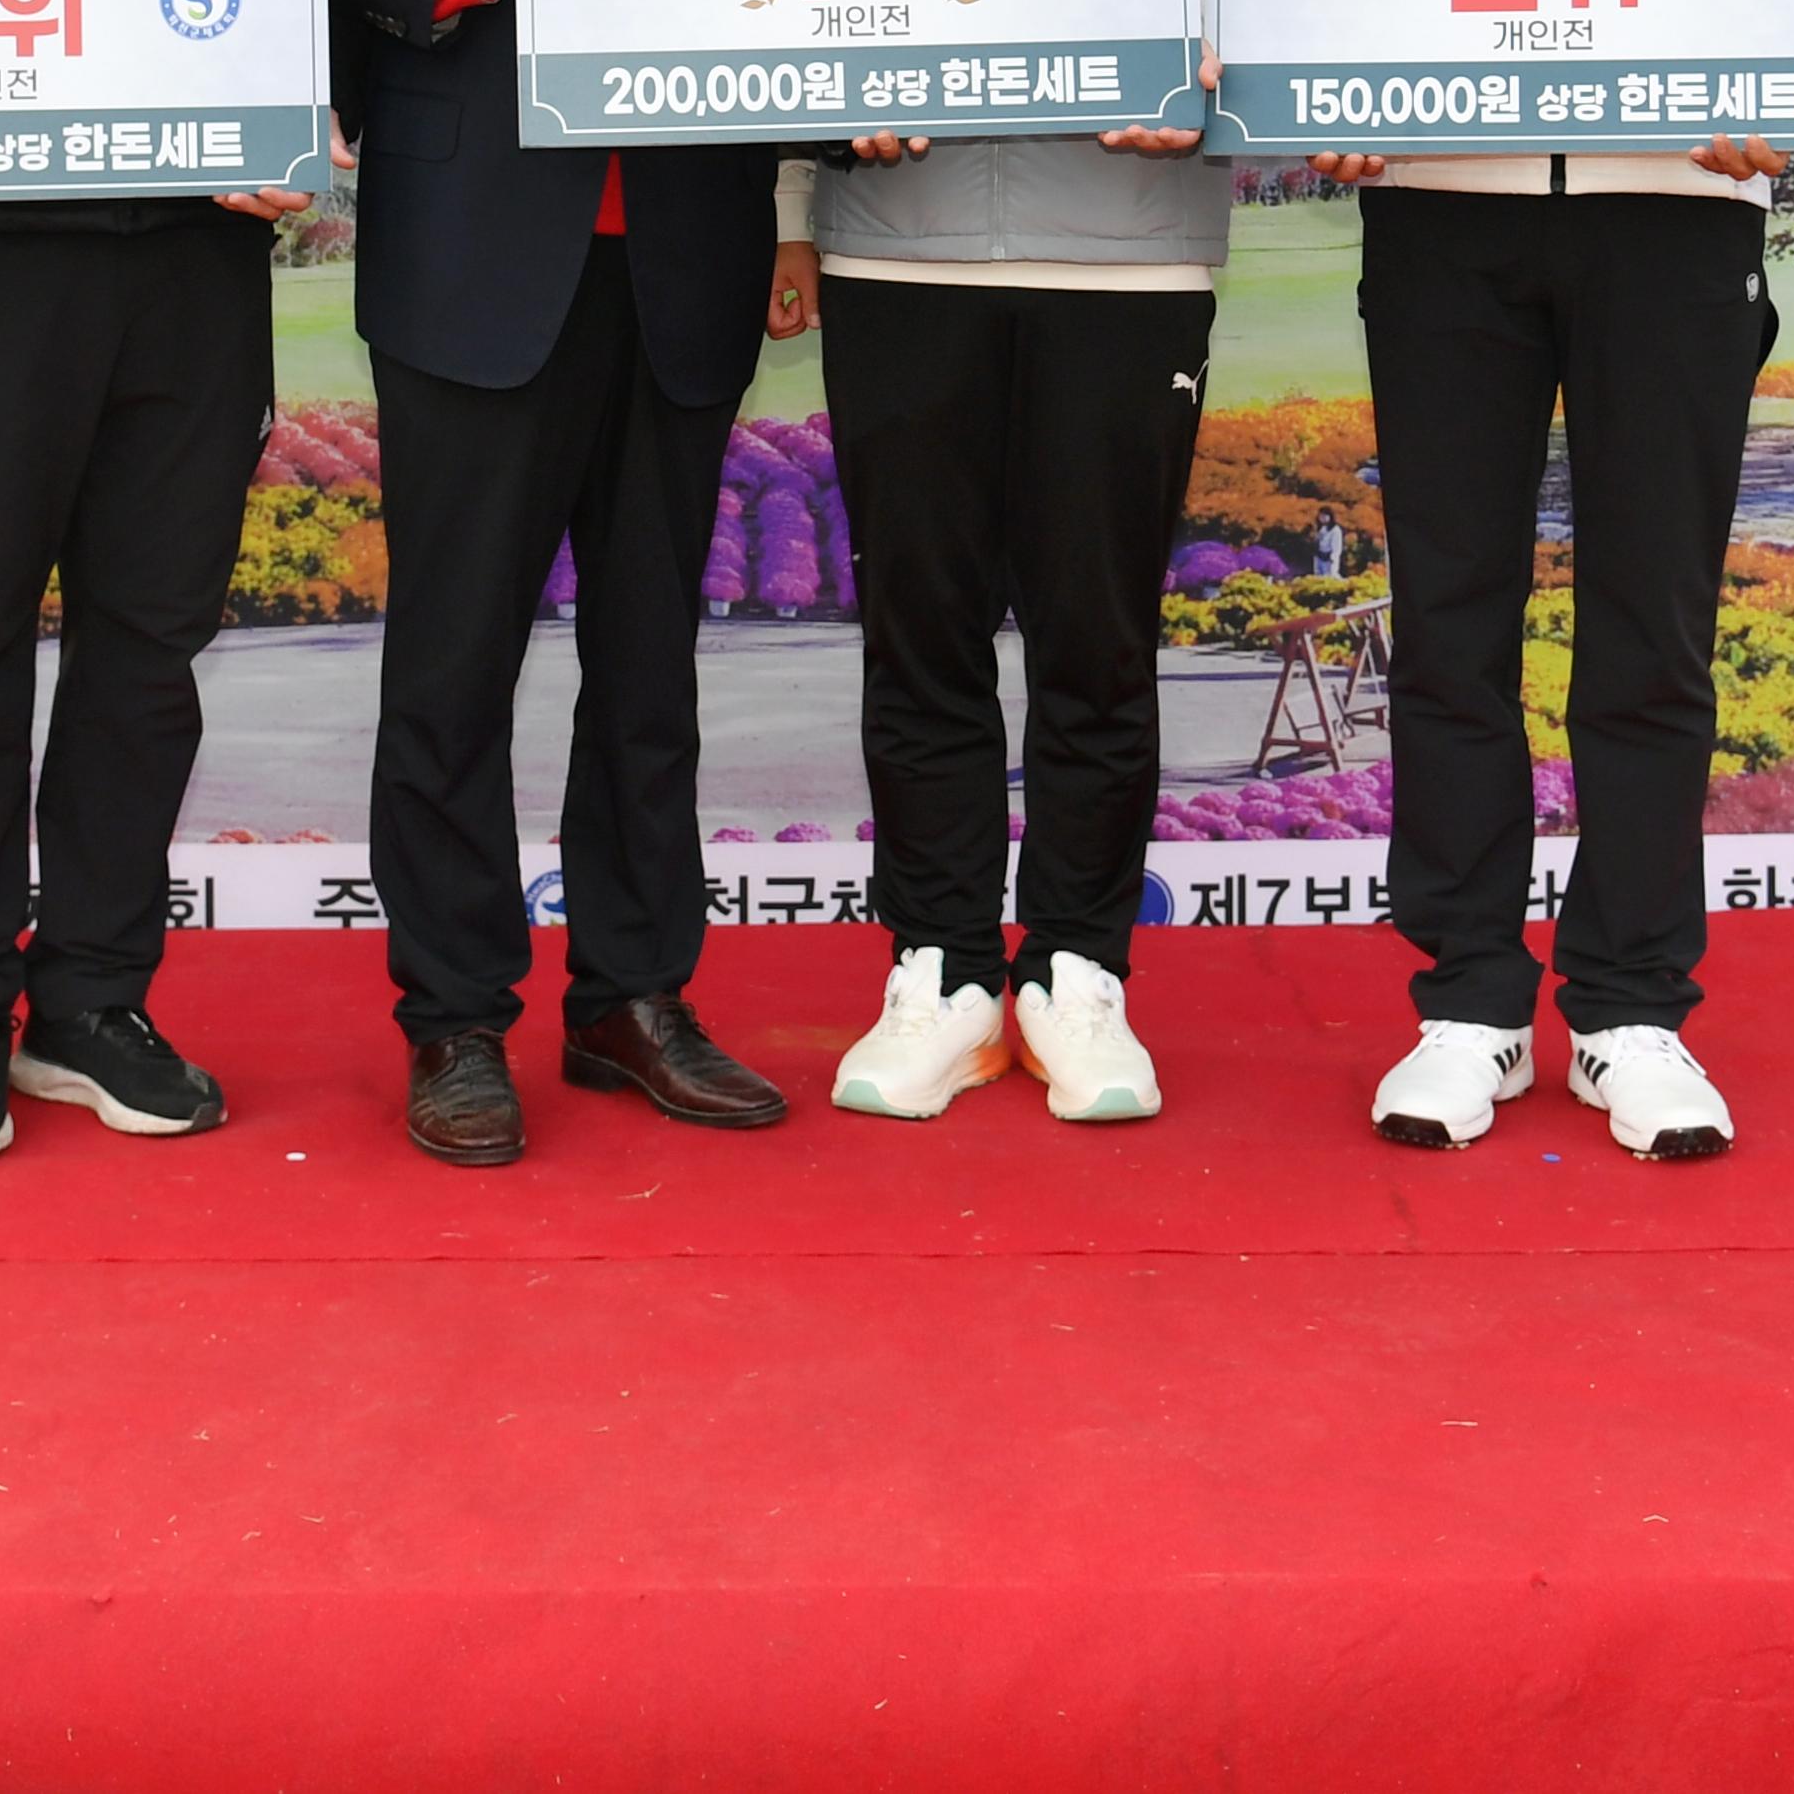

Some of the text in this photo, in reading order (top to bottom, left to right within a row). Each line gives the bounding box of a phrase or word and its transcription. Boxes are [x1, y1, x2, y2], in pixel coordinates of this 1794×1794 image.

[811, 4, 911, 38] 개인전
[1492, 19, 1594, 51] 개인전
[602, 55, 1122, 117] 200,000원 상당 한돈세트
[1289, 75, 1521, 128] 150,000원
[1536, 83, 1607, 123] 상당
[62, 121, 244, 173] 한돈세트
[313, 877, 380, 928] 주
